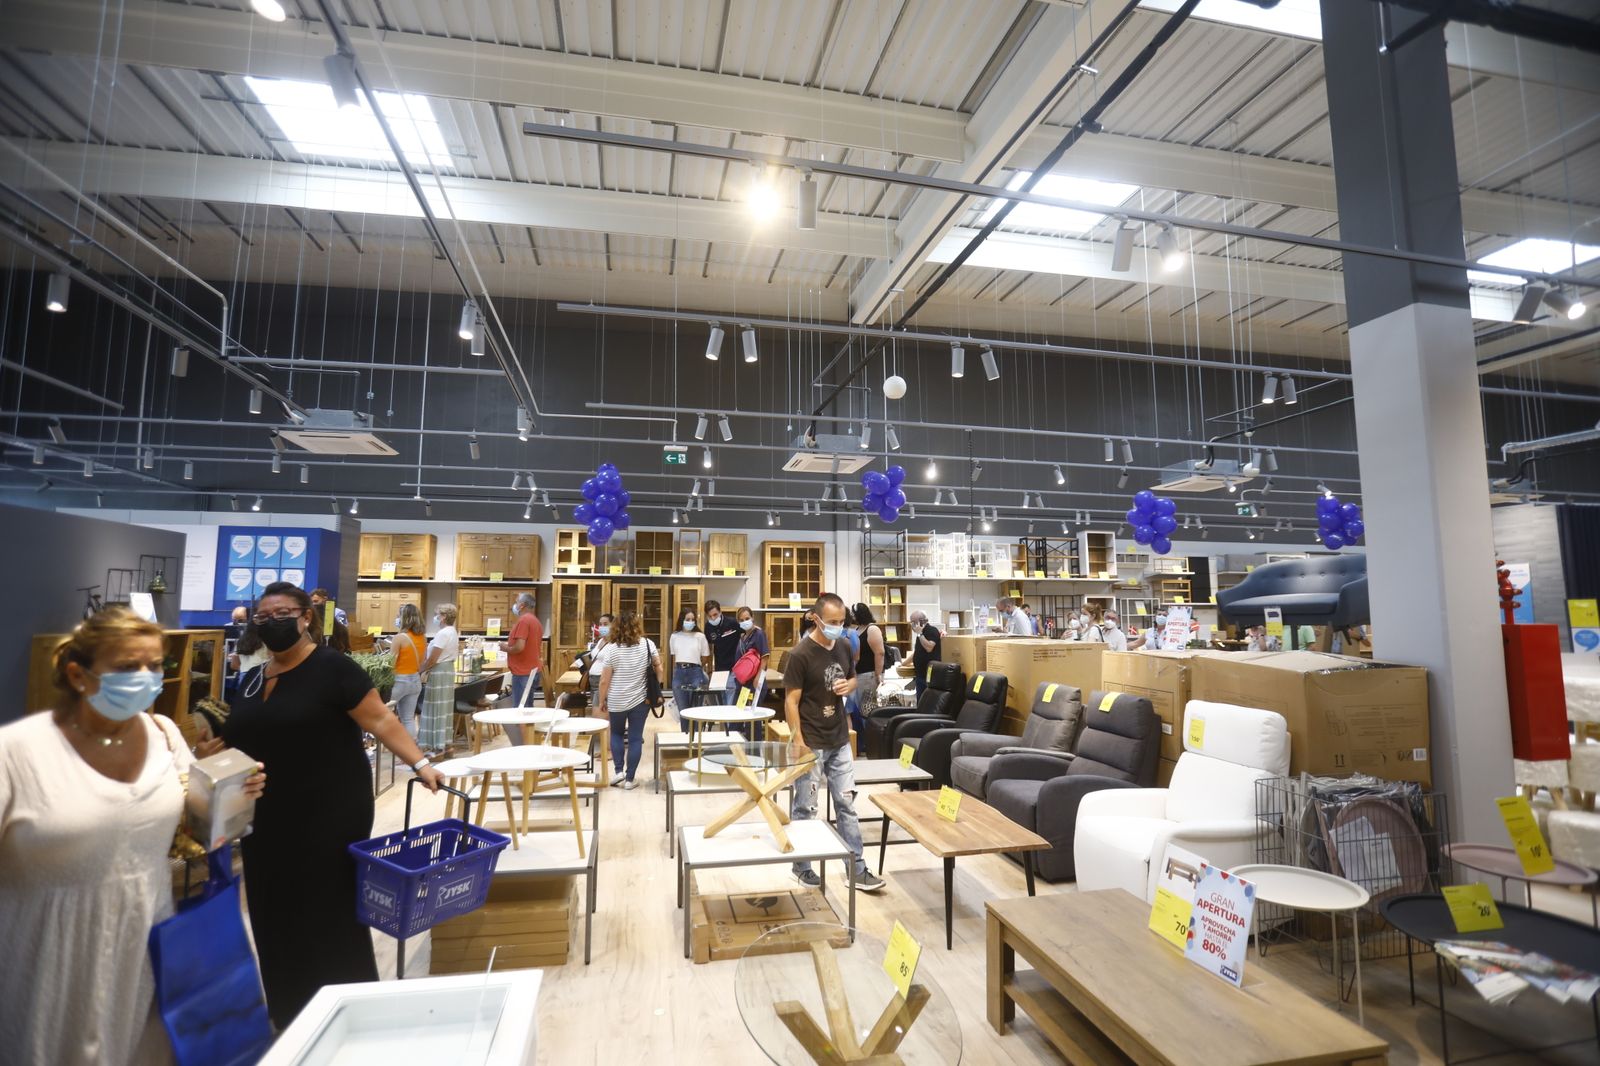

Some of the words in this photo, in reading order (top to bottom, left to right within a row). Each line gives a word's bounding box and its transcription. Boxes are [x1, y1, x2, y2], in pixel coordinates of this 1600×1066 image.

[368, 889, 394, 908] JYSK
[444, 882, 471, 899] JYSK
[1210, 892, 1235, 911] GRAN
[1197, 898, 1245, 928] APERTURA
[1201, 915, 1236, 937] APROVECHA
[1207, 926, 1232, 943] AHORRA
[1202, 938, 1226, 960] 80%
